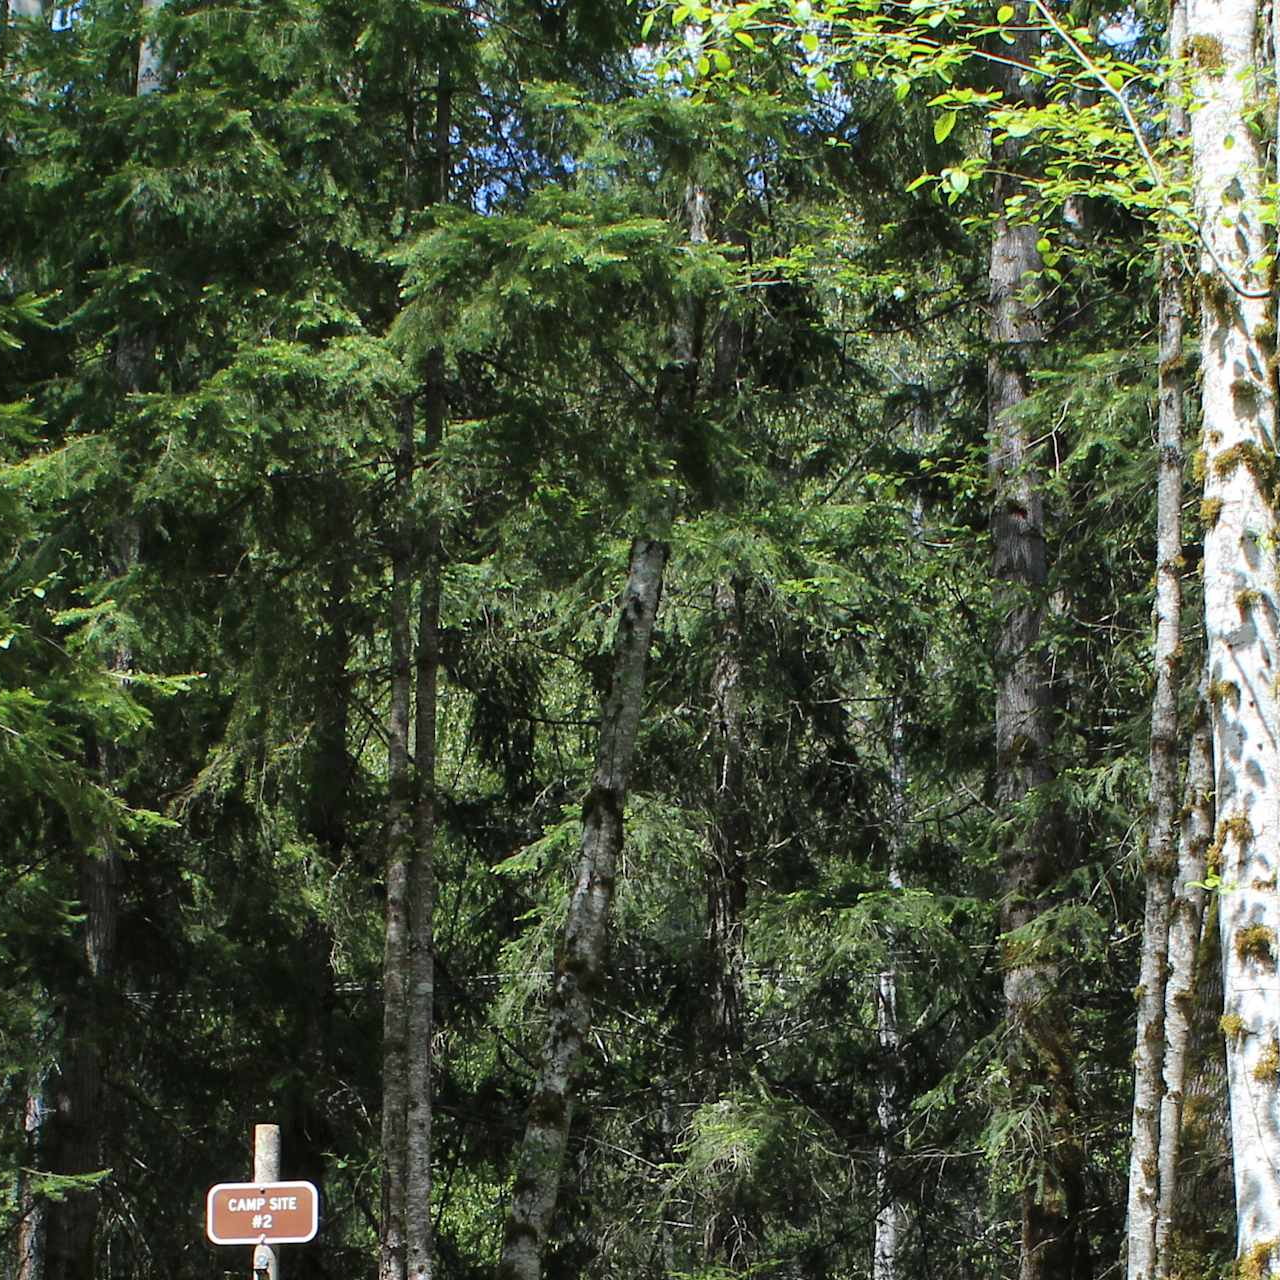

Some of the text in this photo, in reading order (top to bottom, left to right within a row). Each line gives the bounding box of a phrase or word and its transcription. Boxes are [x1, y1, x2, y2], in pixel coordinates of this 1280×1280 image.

[228, 1196, 297, 1212] CAMP SITE
[252, 1214, 273, 1229] #2
